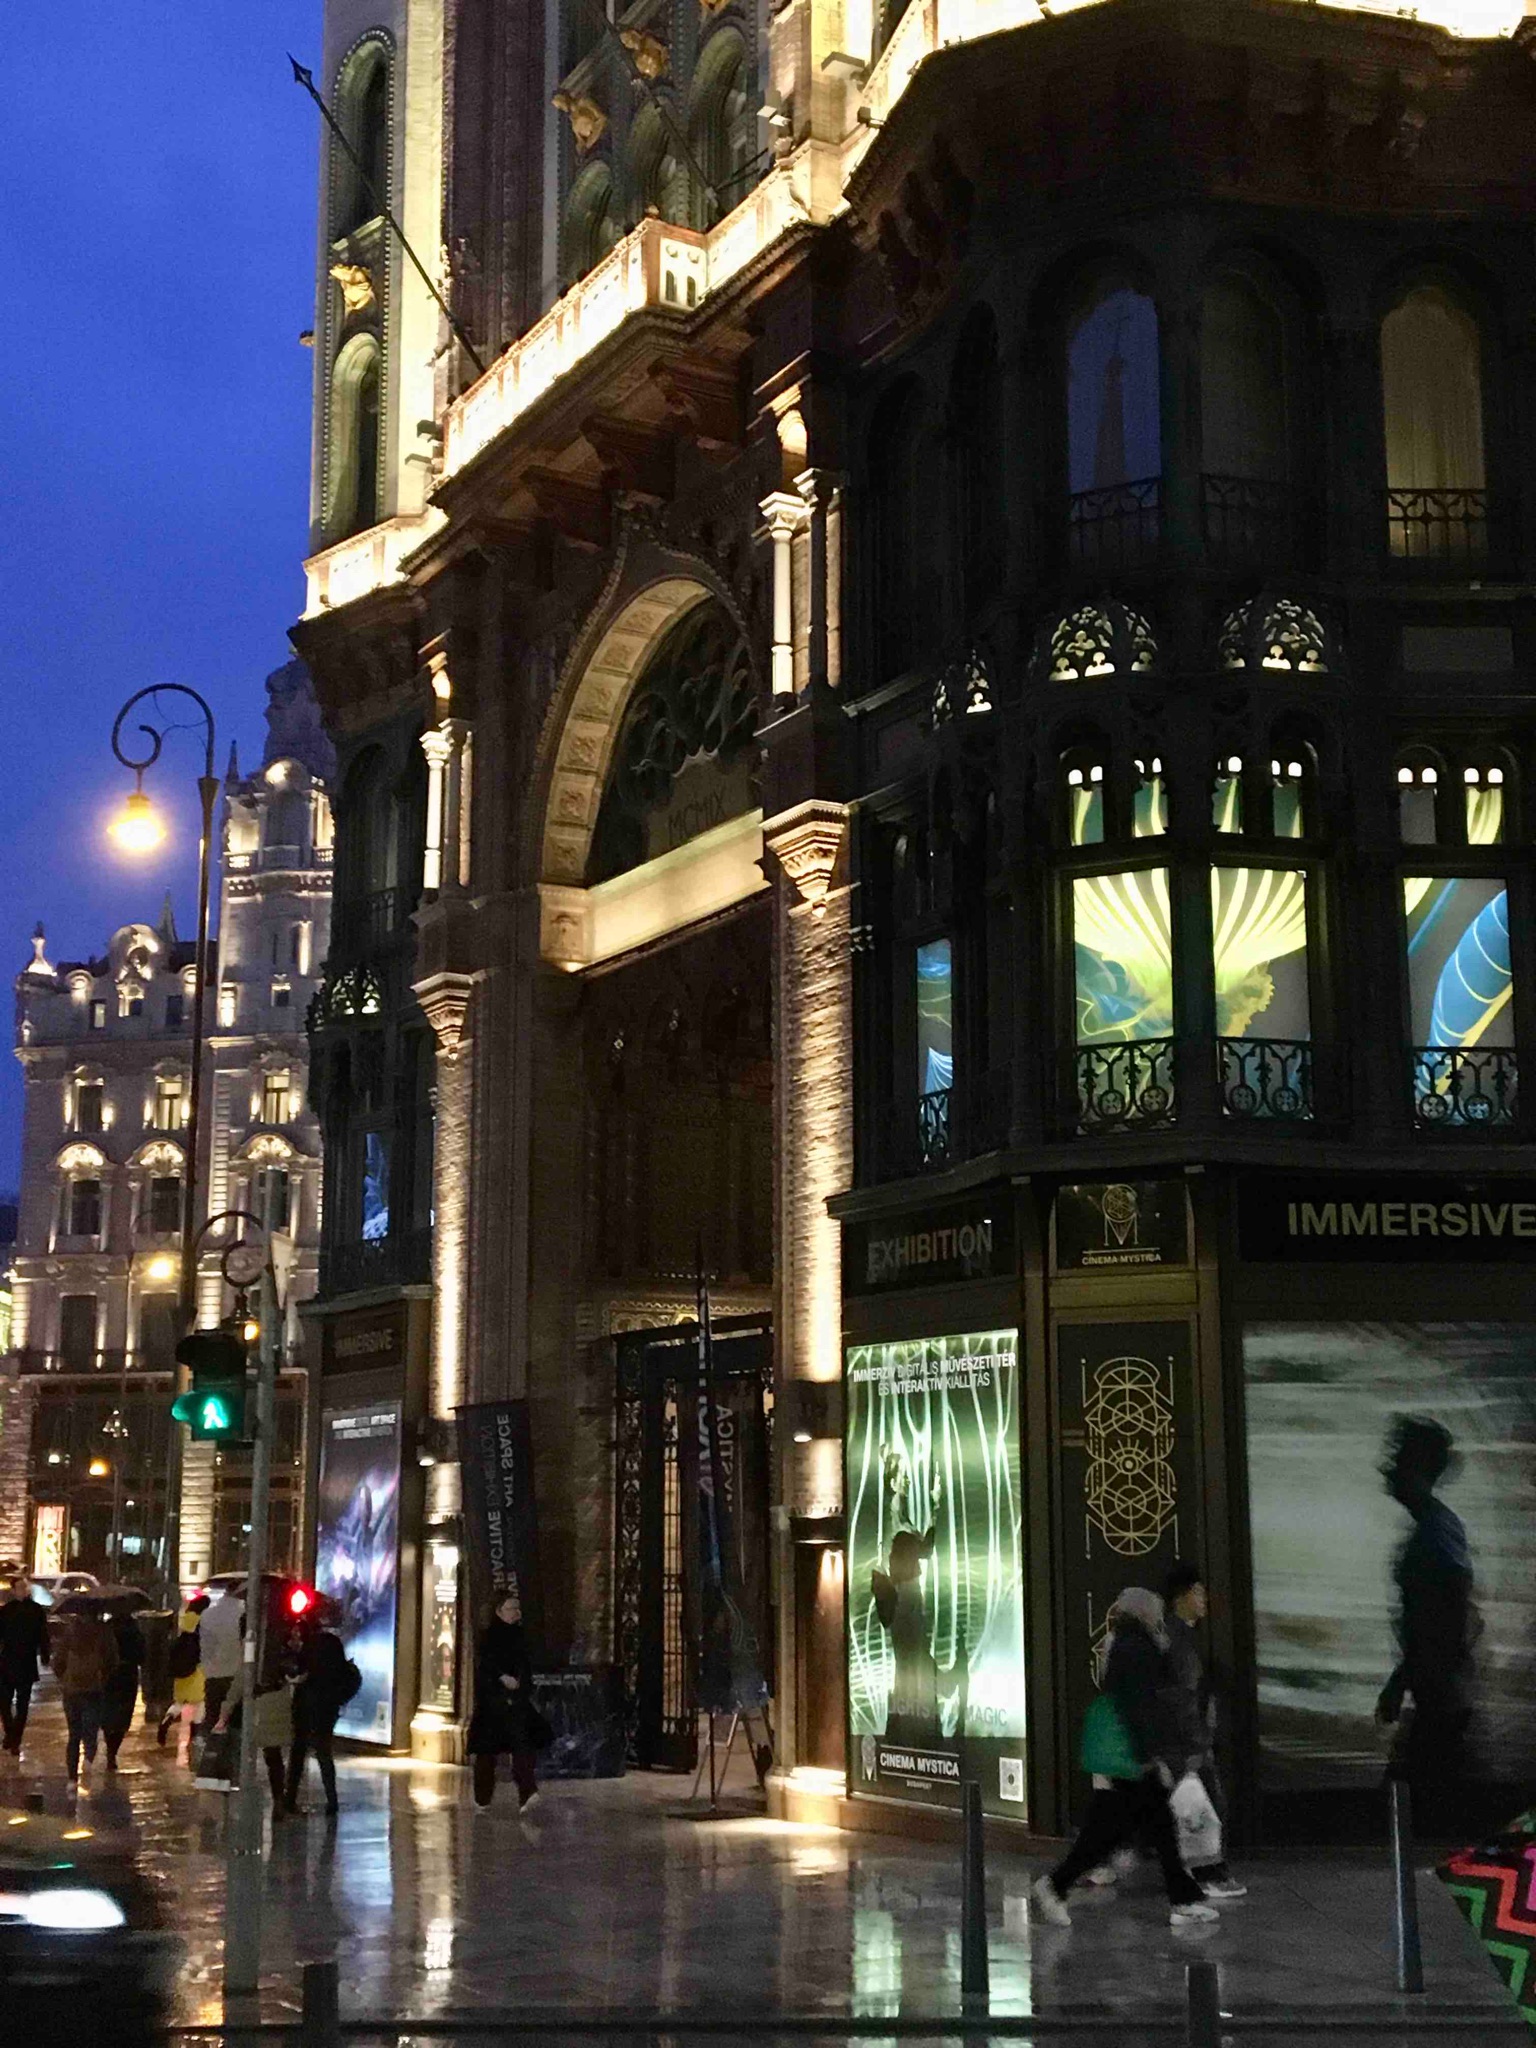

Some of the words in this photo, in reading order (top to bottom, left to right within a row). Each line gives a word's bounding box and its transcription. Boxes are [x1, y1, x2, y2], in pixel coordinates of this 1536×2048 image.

[1287, 1202, 1536, 1237] IMMERSIVE
[867, 1224, 993, 1270] EXHIBITION
[1081, 1255, 1118, 1266] CINEMA
[1120, 1253, 1162, 1264] MYSTICA
[880, 1752, 916, 1771] CINEMA
[917, 1757, 960, 1777] MYSTICA
